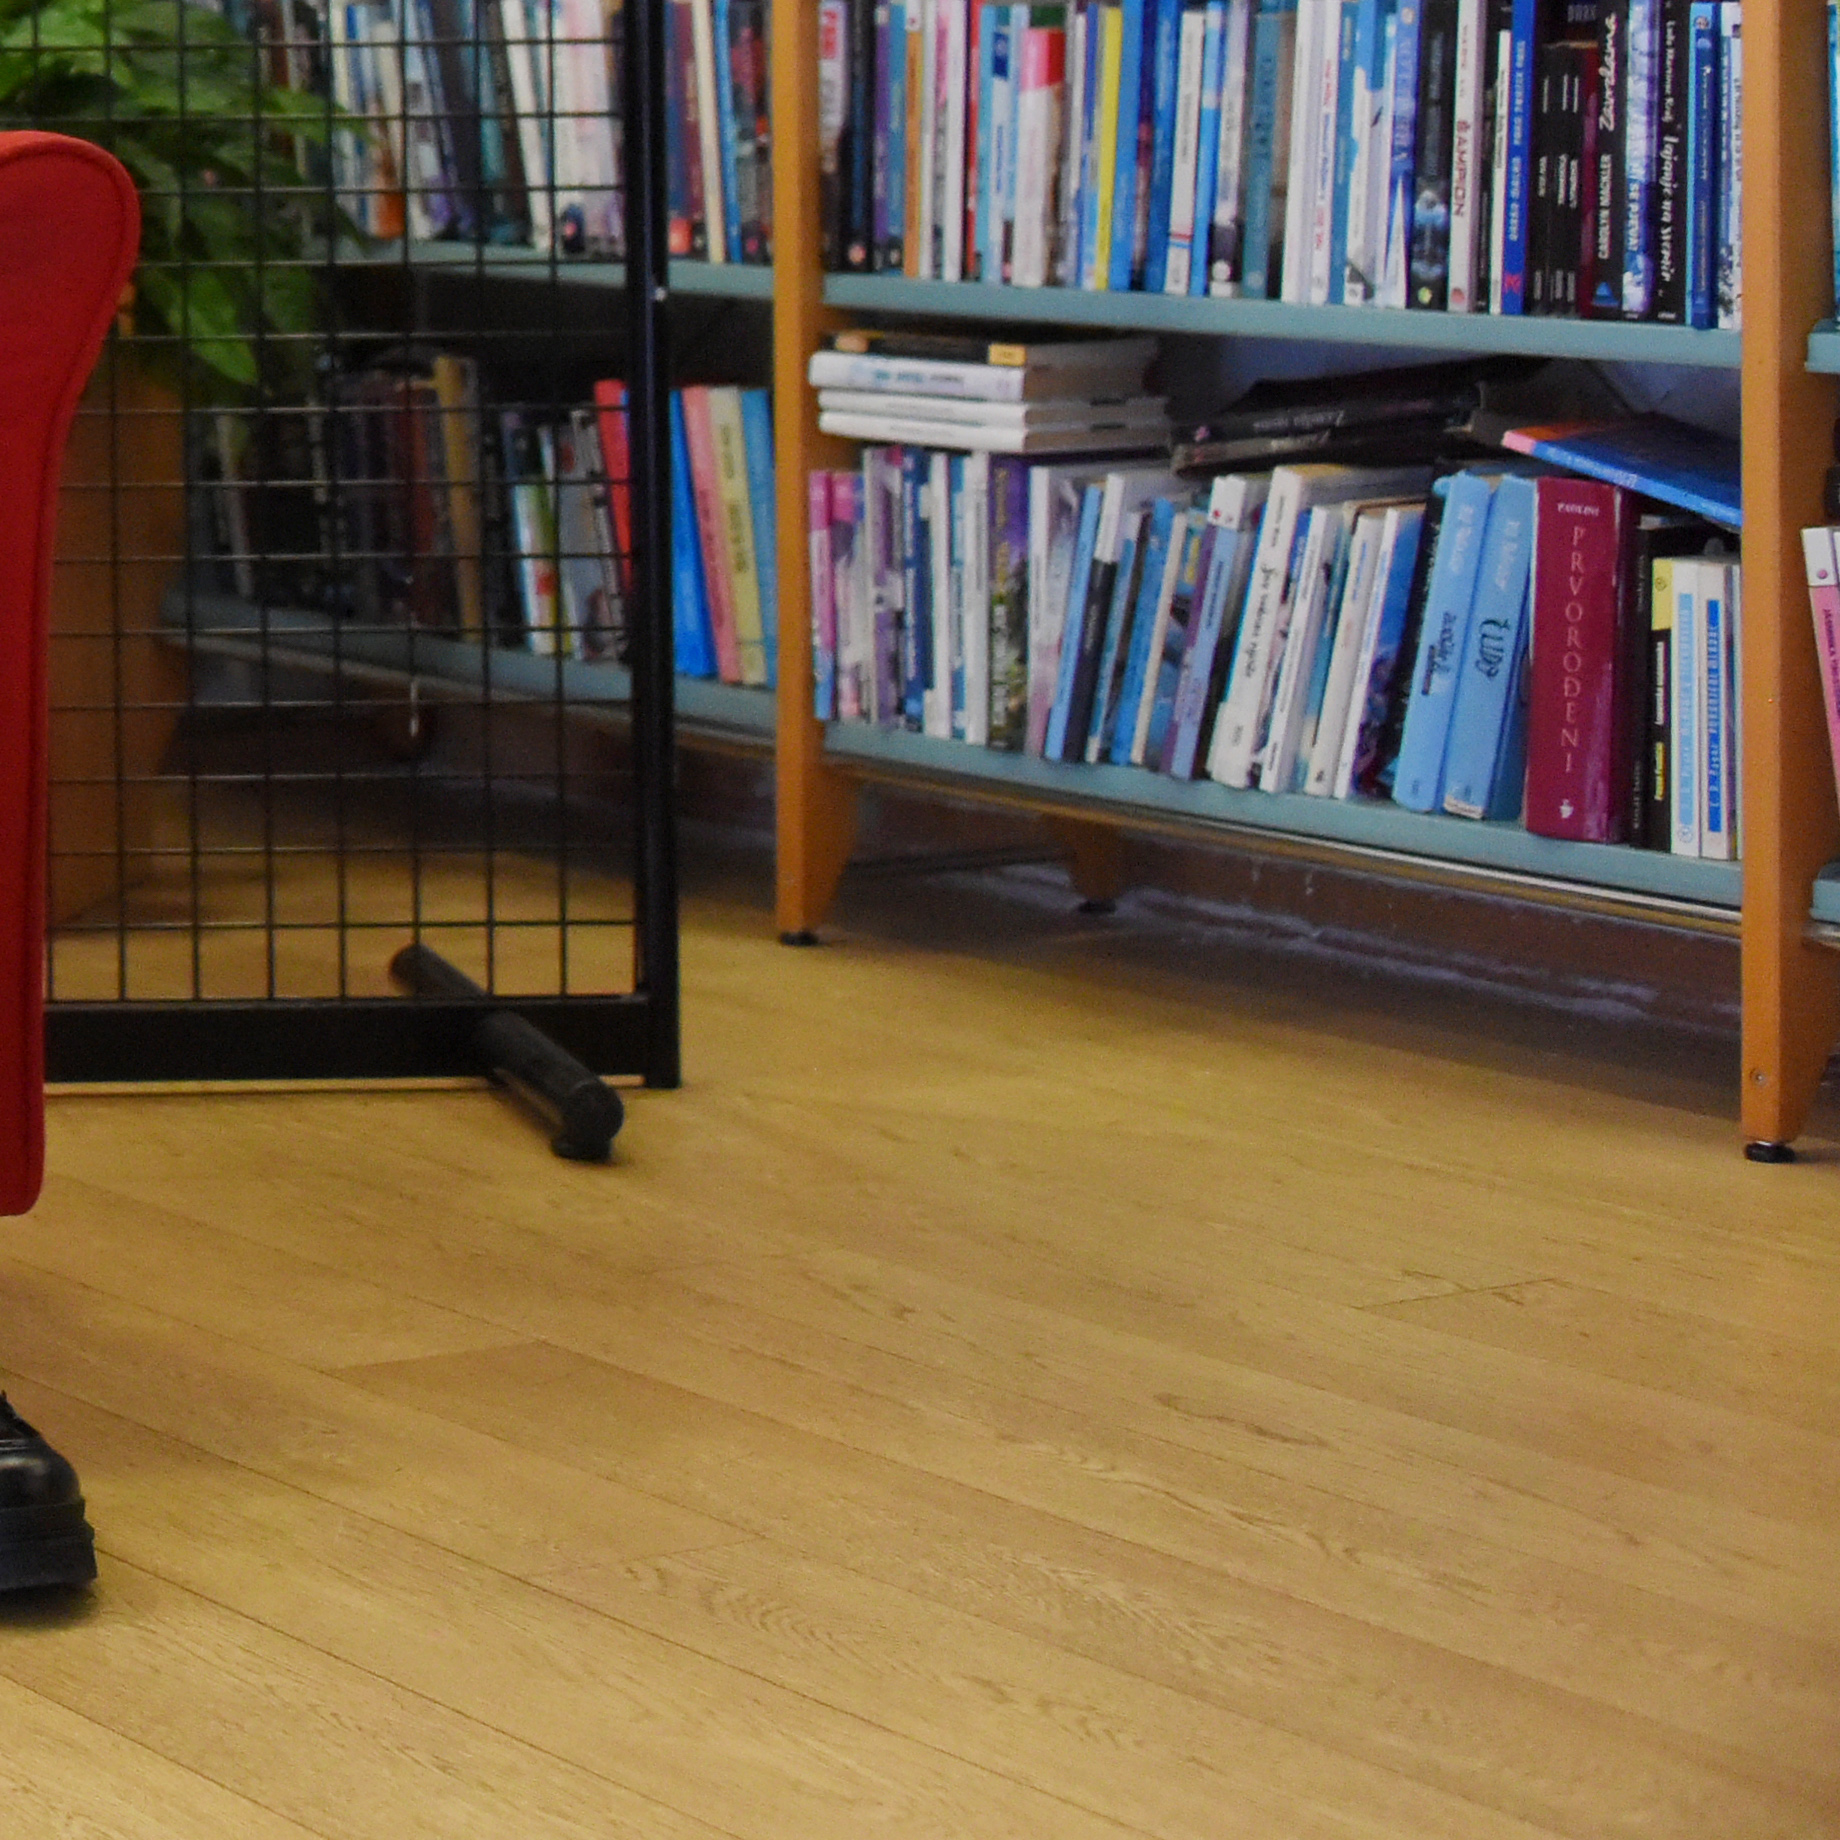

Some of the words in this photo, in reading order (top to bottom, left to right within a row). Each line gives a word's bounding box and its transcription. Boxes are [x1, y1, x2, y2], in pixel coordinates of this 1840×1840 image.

[1453, 120, 1472, 218] ŠAMPON
[1598, 154, 1612, 207] MACKLER
[1659, 135, 1679, 195] Lajanje
[1597, 208, 1611, 259] CAROLYN
[1661, 199, 1674, 223] na
